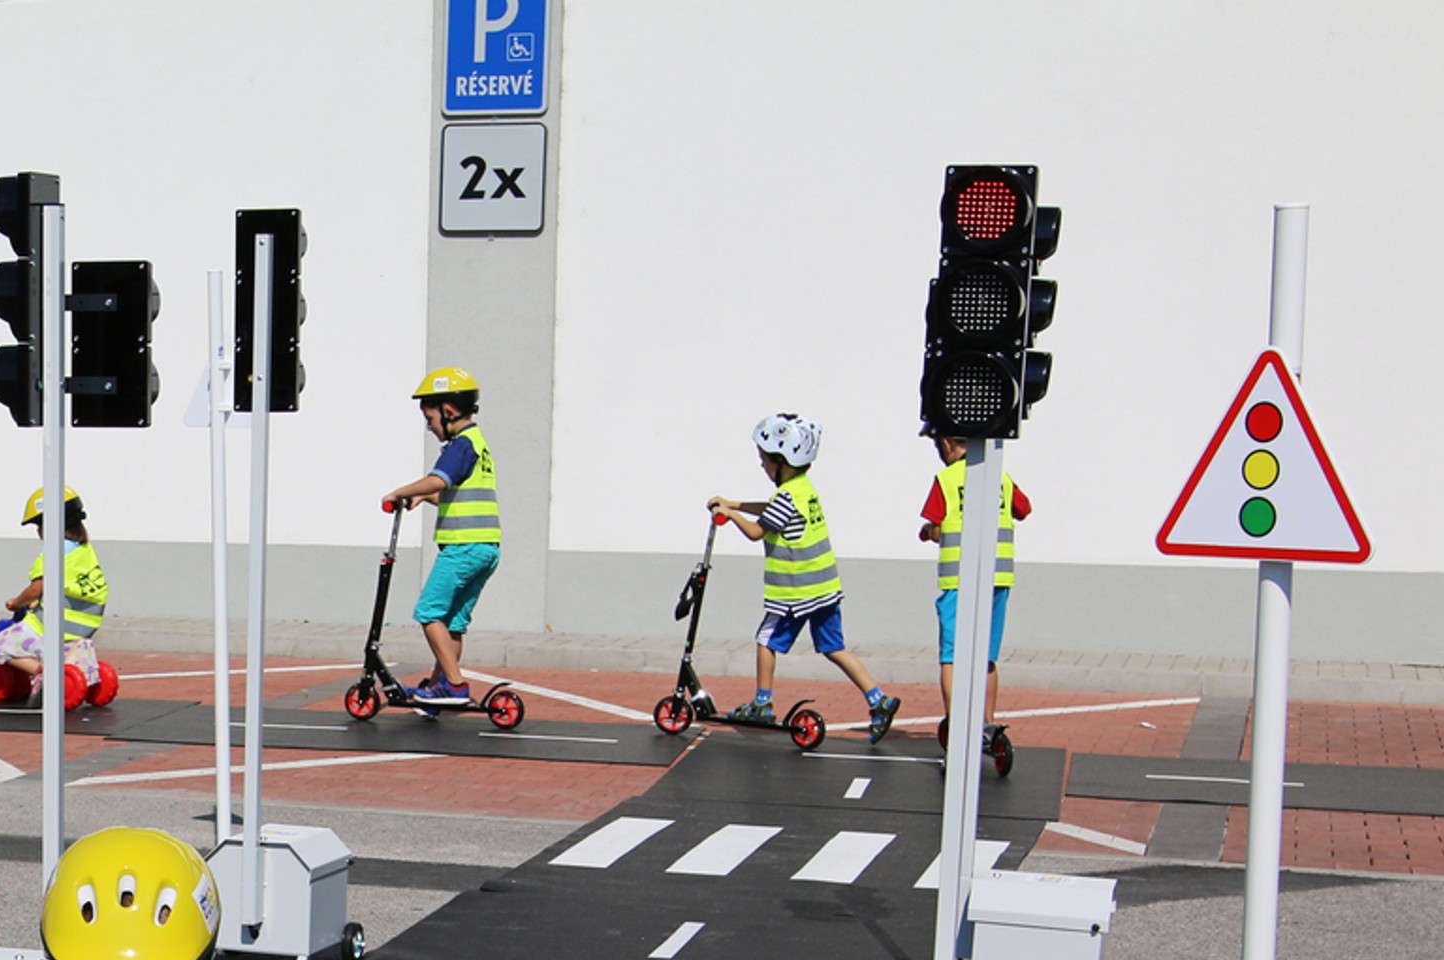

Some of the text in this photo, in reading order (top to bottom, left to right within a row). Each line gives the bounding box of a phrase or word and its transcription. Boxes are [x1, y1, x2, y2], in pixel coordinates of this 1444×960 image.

[474, 0, 519, 63] P
[456, 69, 533, 97] RÉSERVÉ
[459, 155, 526, 200] 2x
